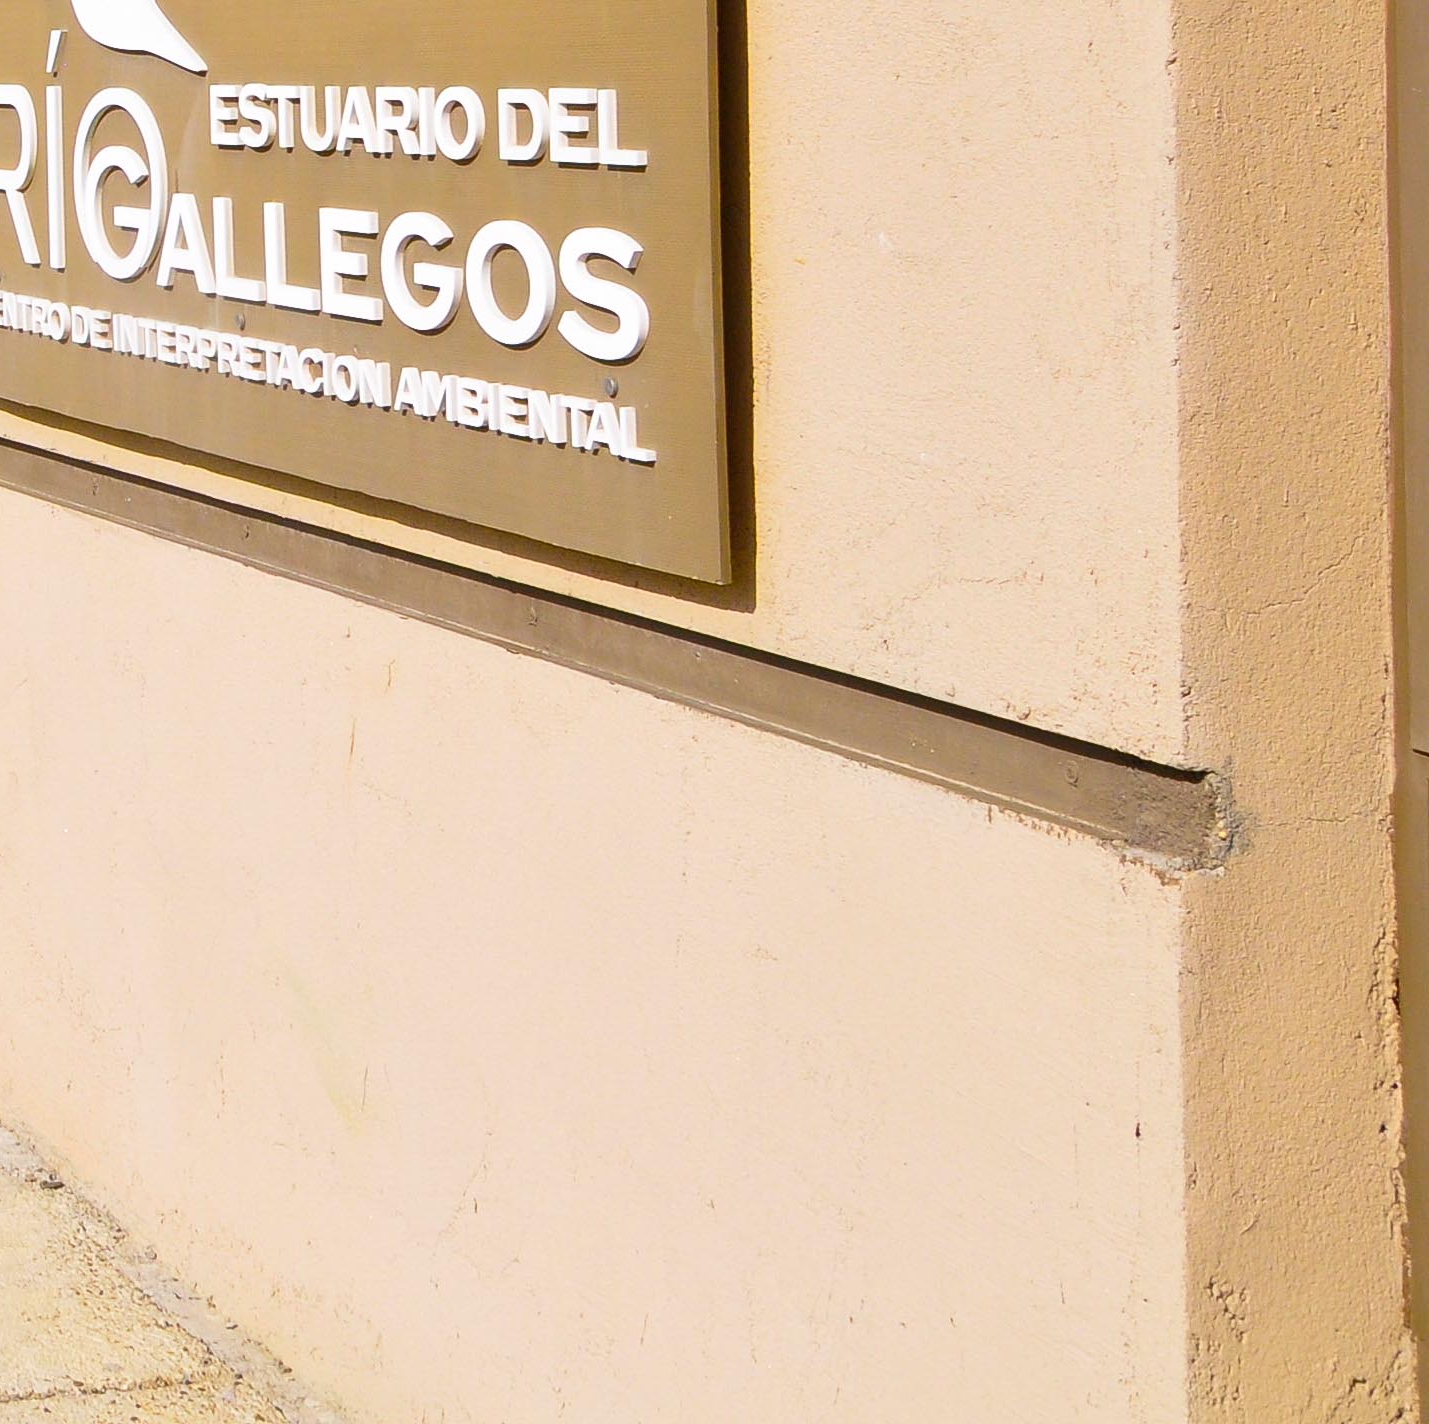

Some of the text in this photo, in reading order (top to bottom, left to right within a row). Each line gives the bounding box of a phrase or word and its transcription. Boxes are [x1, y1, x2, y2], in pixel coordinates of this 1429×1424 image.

[210, 83, 649, 168] ESTUARIO DEL
[85, 145, 651, 362] GALLEGOS
[71, 305, 113, 351] DE
[113, 313, 391, 409] INTERPRETACION
[394, 367, 657, 463] AMBIENTAL
